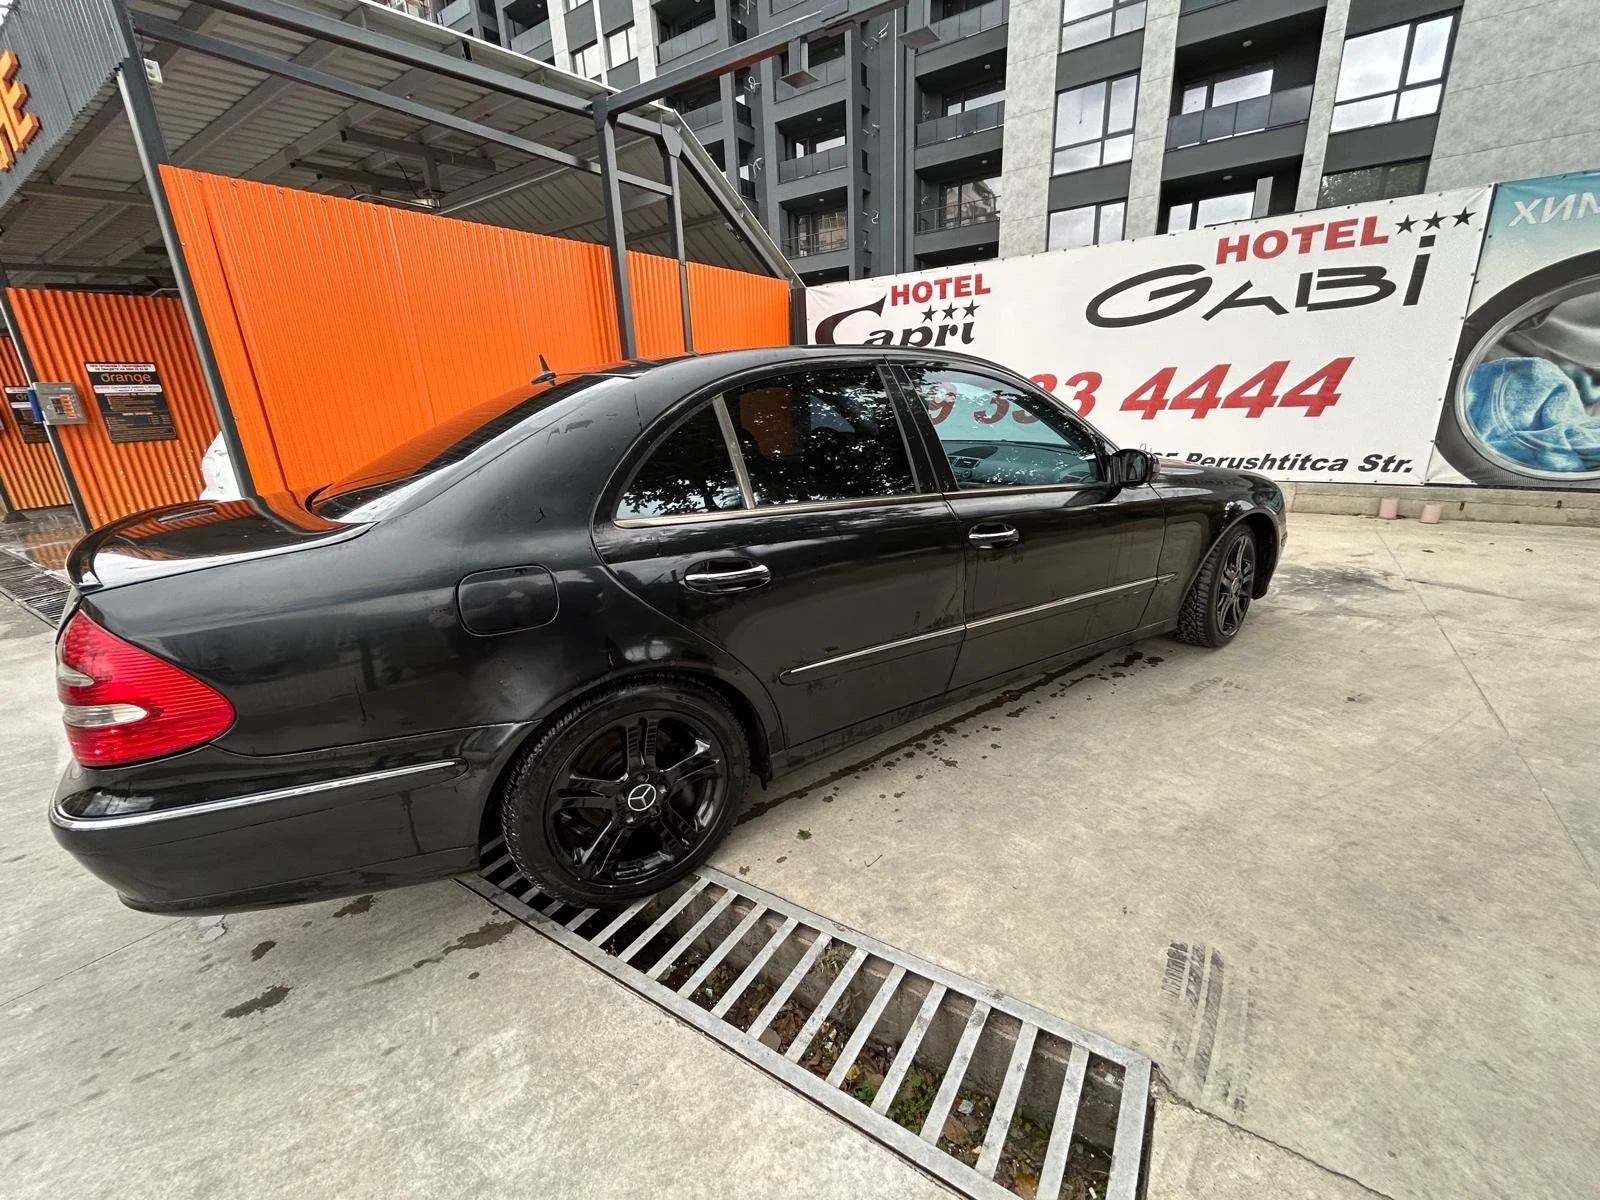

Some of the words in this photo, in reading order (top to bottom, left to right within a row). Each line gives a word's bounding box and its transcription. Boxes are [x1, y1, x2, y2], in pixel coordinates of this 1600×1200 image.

[1216, 216, 1389, 264] HOTEL
[891, 273, 991, 306] HOTEL
[815, 293, 976, 347] Capri
[1120, 357, 1355, 421] 4444
[1185, 453, 1349, 471] Perushtitca
[1357, 453, 1413, 473] Str.
